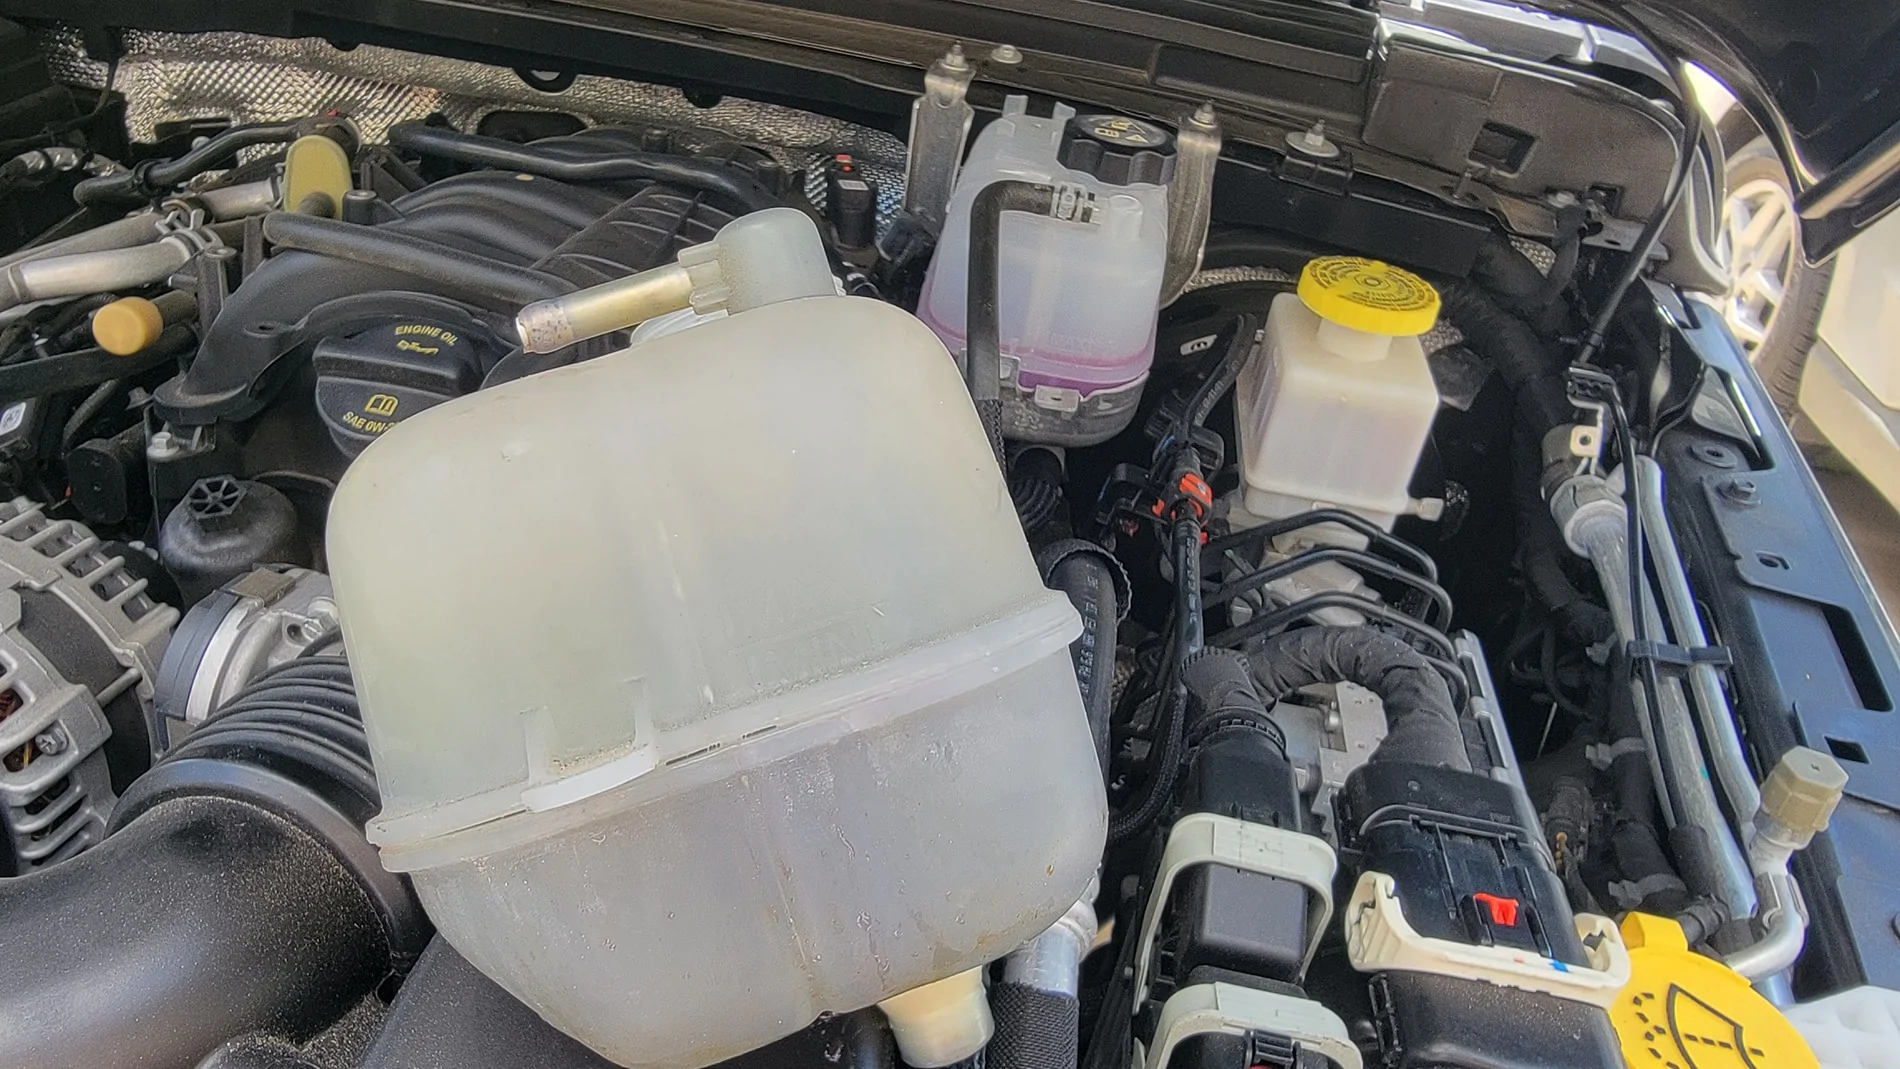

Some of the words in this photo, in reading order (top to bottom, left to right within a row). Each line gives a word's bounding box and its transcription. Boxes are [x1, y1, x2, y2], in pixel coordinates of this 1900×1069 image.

[395, 324, 442, 337] ENGINE
[440, 331, 458, 346] OIL
[343, 411, 367, 429] SAE
